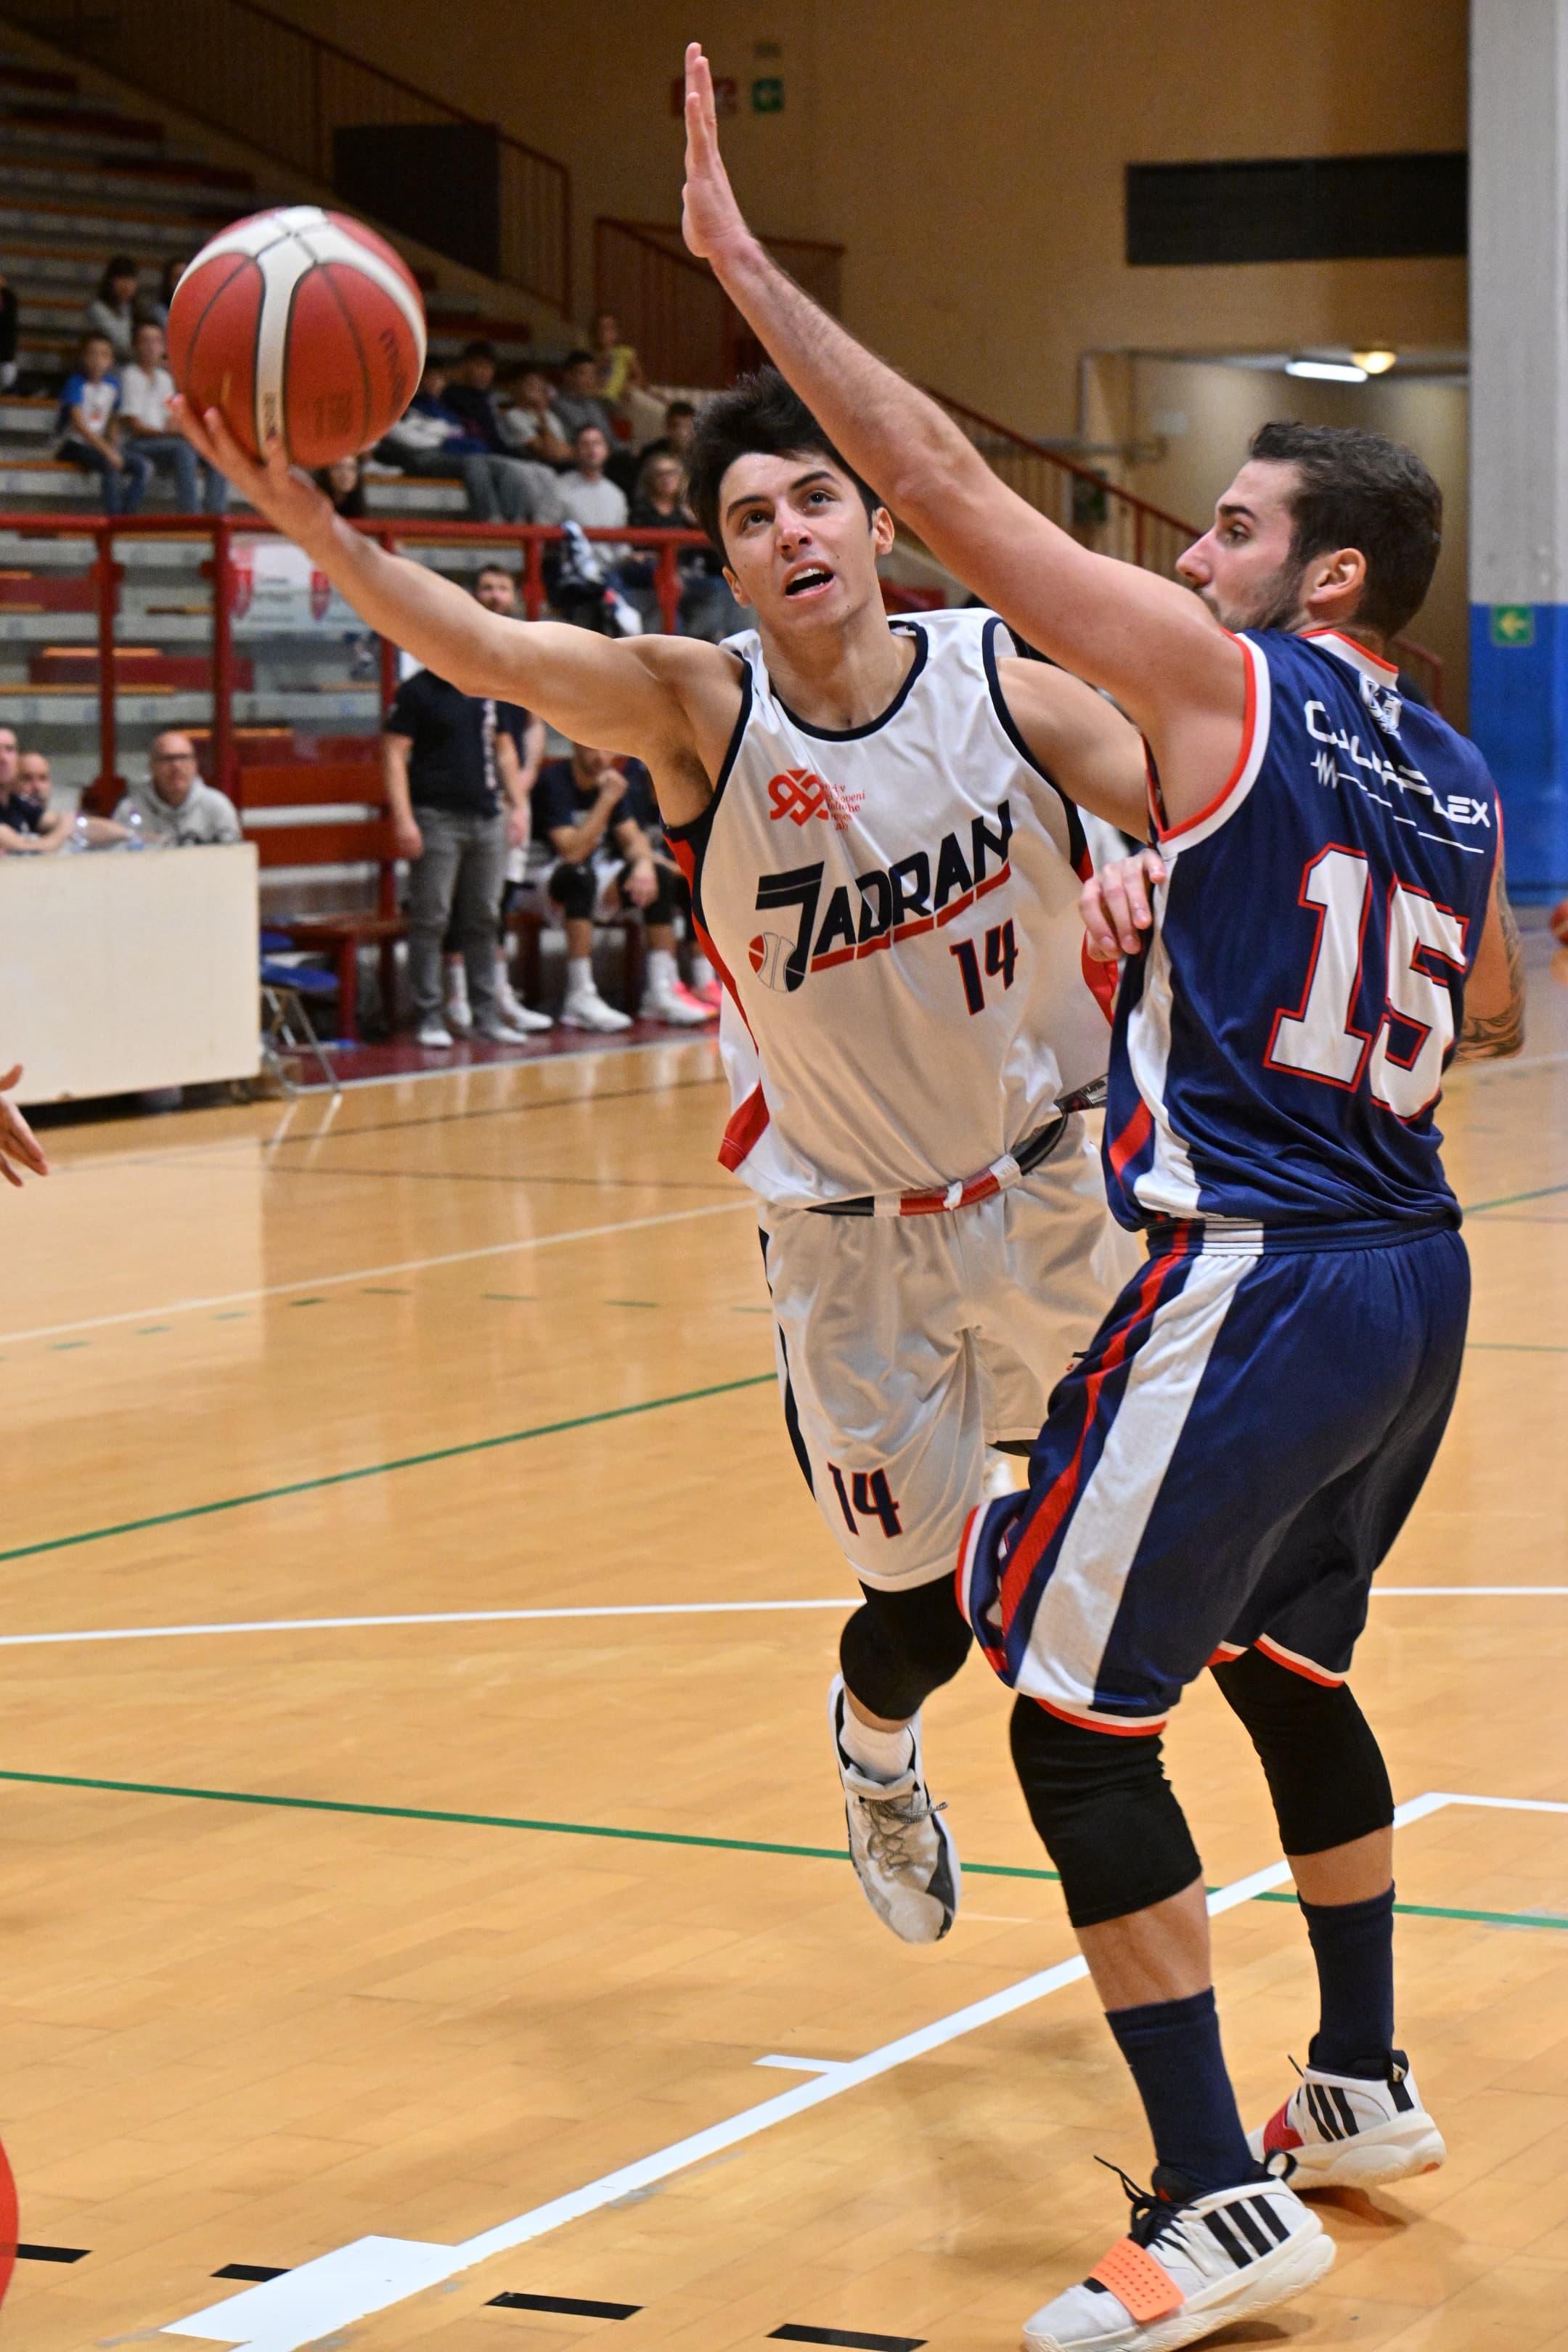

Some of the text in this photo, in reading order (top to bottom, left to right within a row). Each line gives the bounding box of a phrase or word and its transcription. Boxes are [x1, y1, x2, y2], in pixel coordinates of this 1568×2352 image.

[749, 800, 1013, 992] JADRAN
[950, 918, 1018, 1016] 14
[1264, 842, 1470, 1124] 15
[827, 1461, 903, 1539] 14
